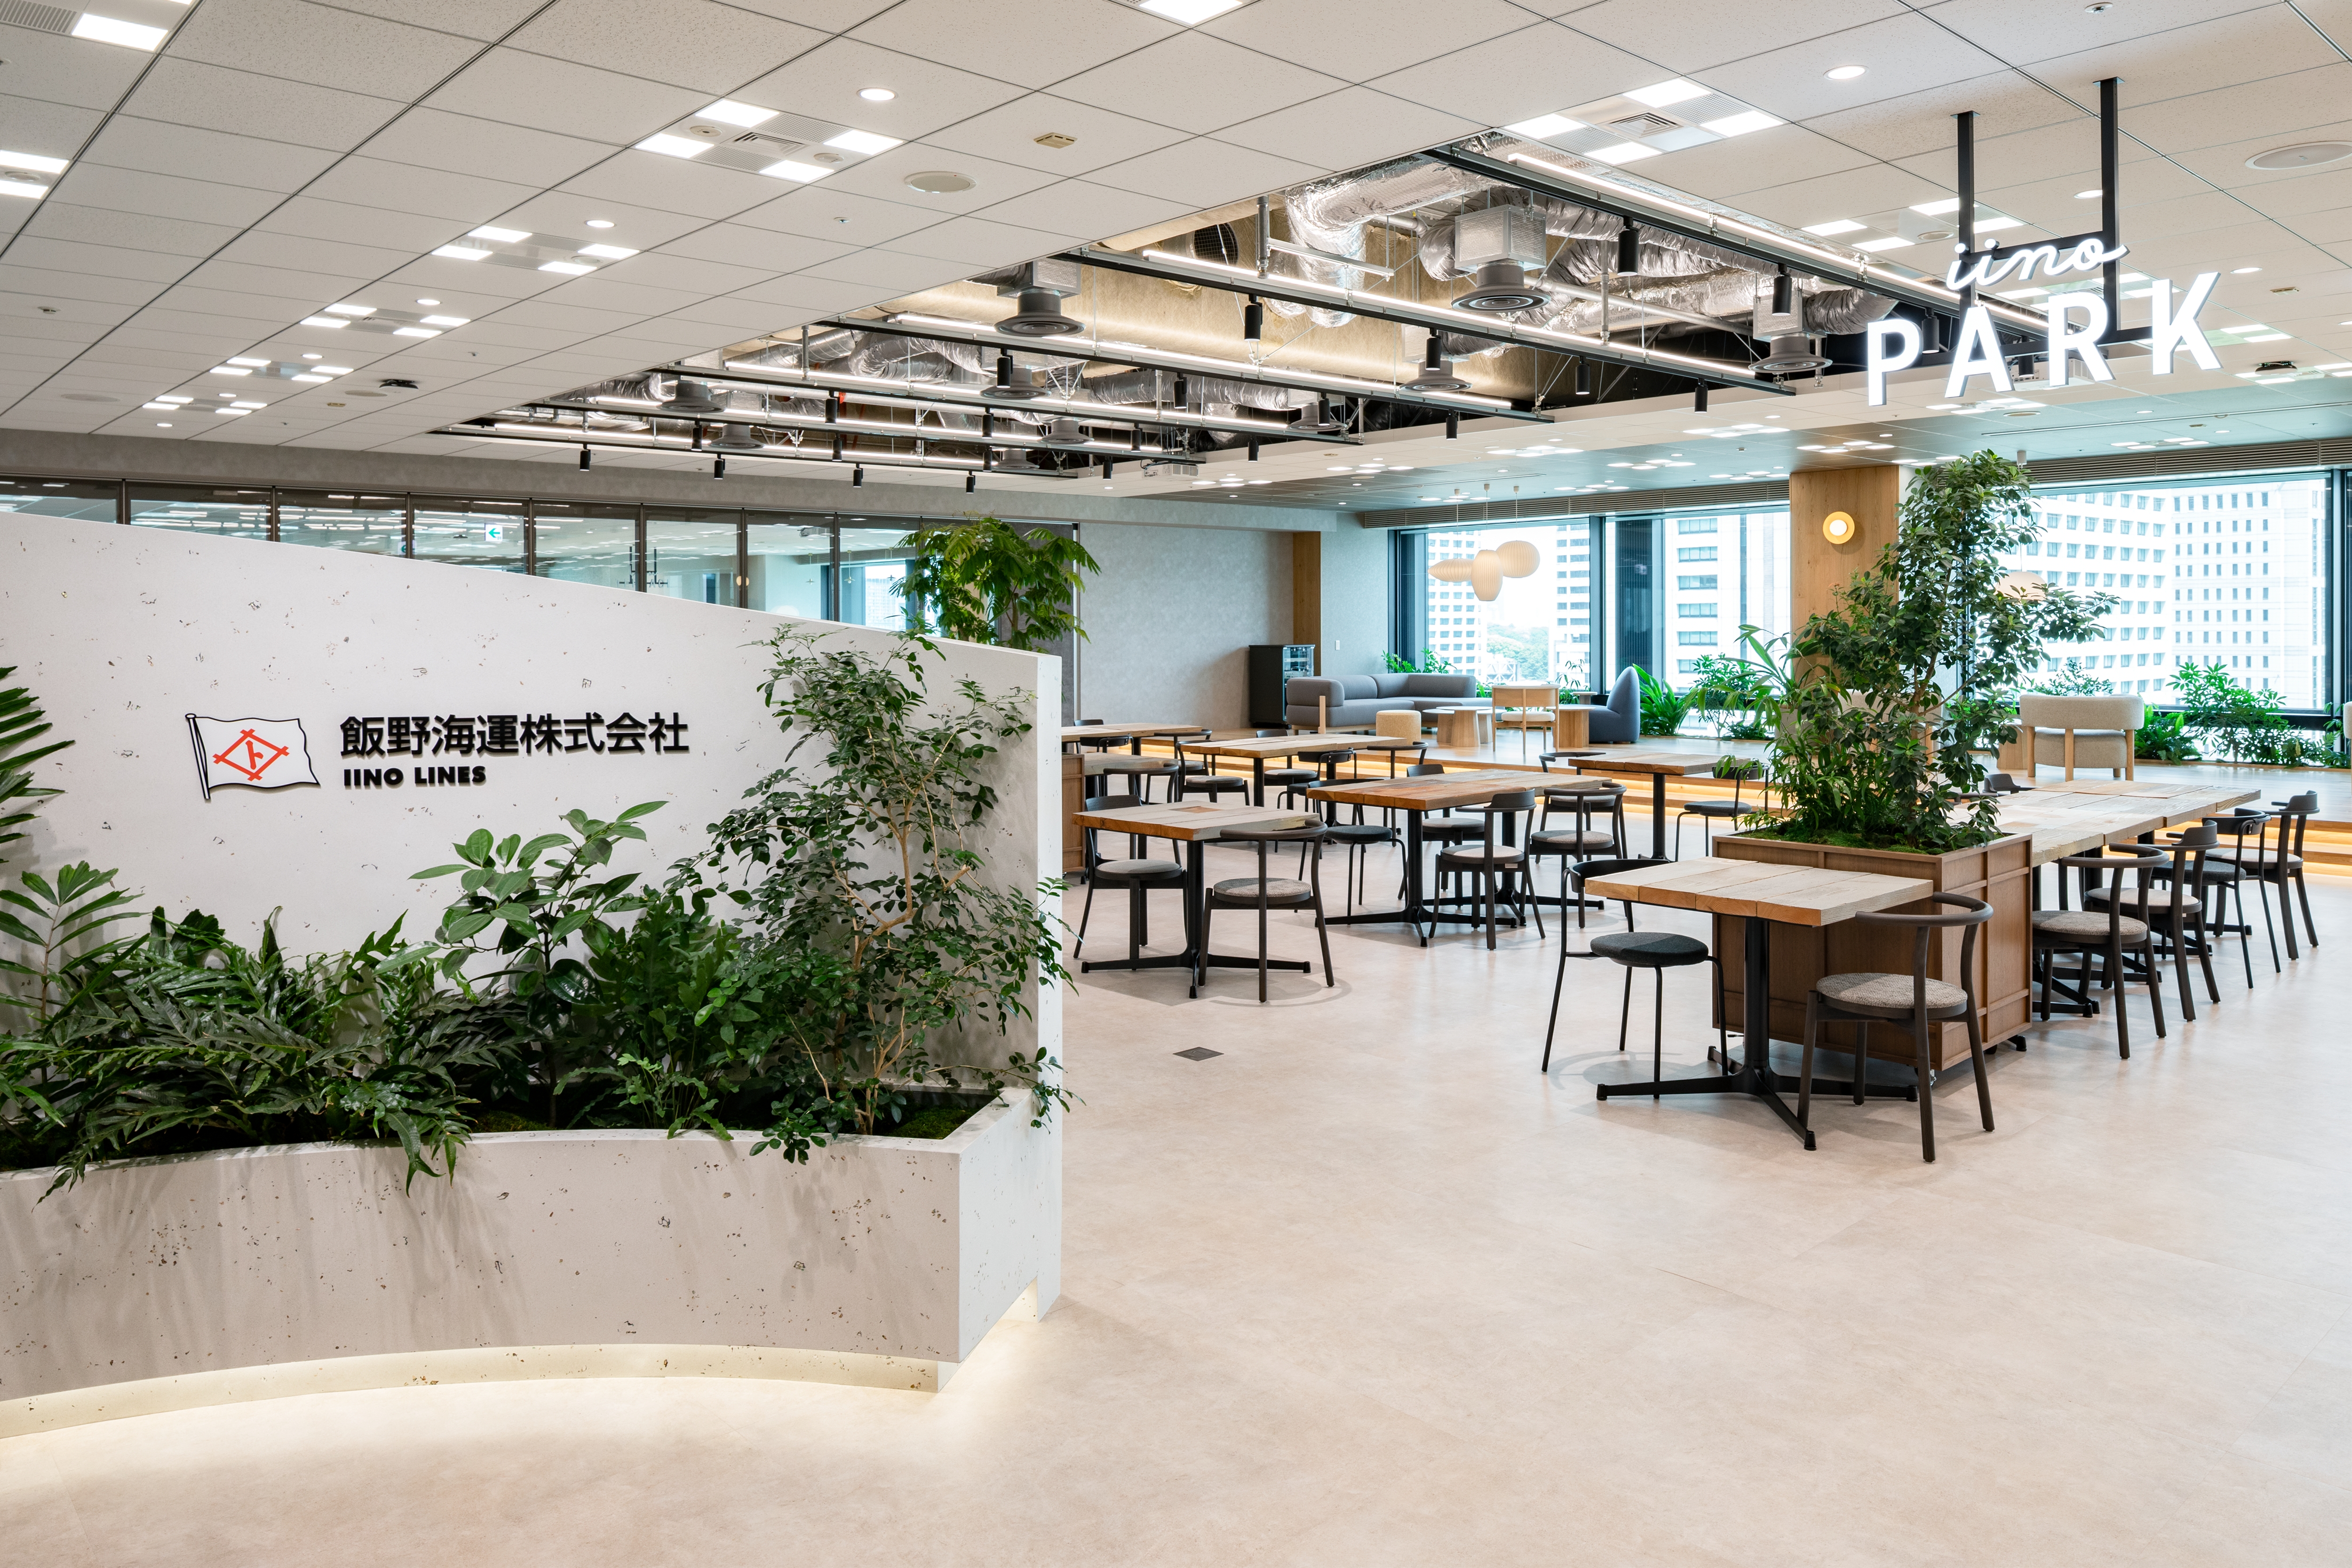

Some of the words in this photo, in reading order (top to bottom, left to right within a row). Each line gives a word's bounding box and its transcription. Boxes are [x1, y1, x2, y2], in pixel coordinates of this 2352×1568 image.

[1946, 239, 2130, 290] iino
[1867, 271, 2222, 406] PARK
[340, 712, 689, 756] 飯野海運株式会社
[344, 768, 404, 787] IINO
[414, 766, 486, 785] LINES
